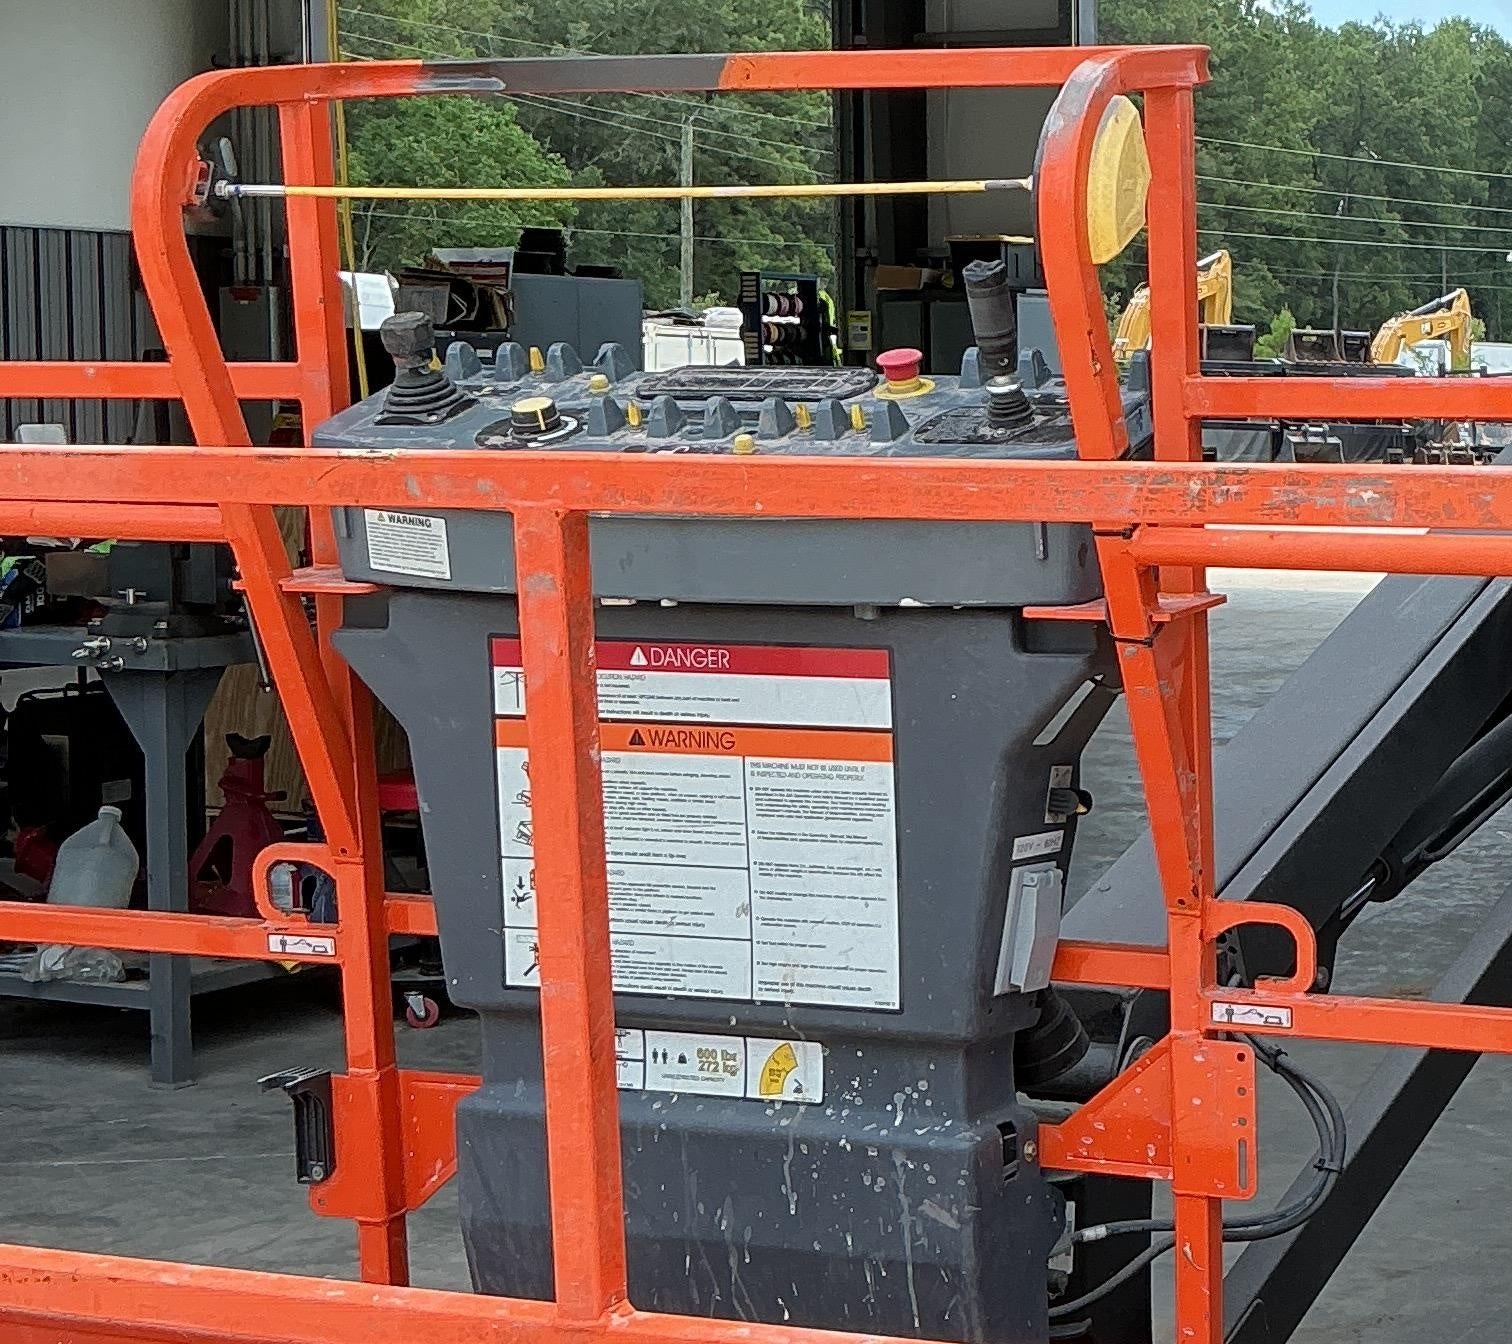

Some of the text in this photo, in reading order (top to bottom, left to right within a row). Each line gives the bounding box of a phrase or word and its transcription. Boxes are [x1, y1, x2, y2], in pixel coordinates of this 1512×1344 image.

[387, 513, 432, 528] WARNING
[650, 646, 730, 669] DANGER
[648, 729, 735, 750] WARNING
[698, 1059, 719, 1072] 272
